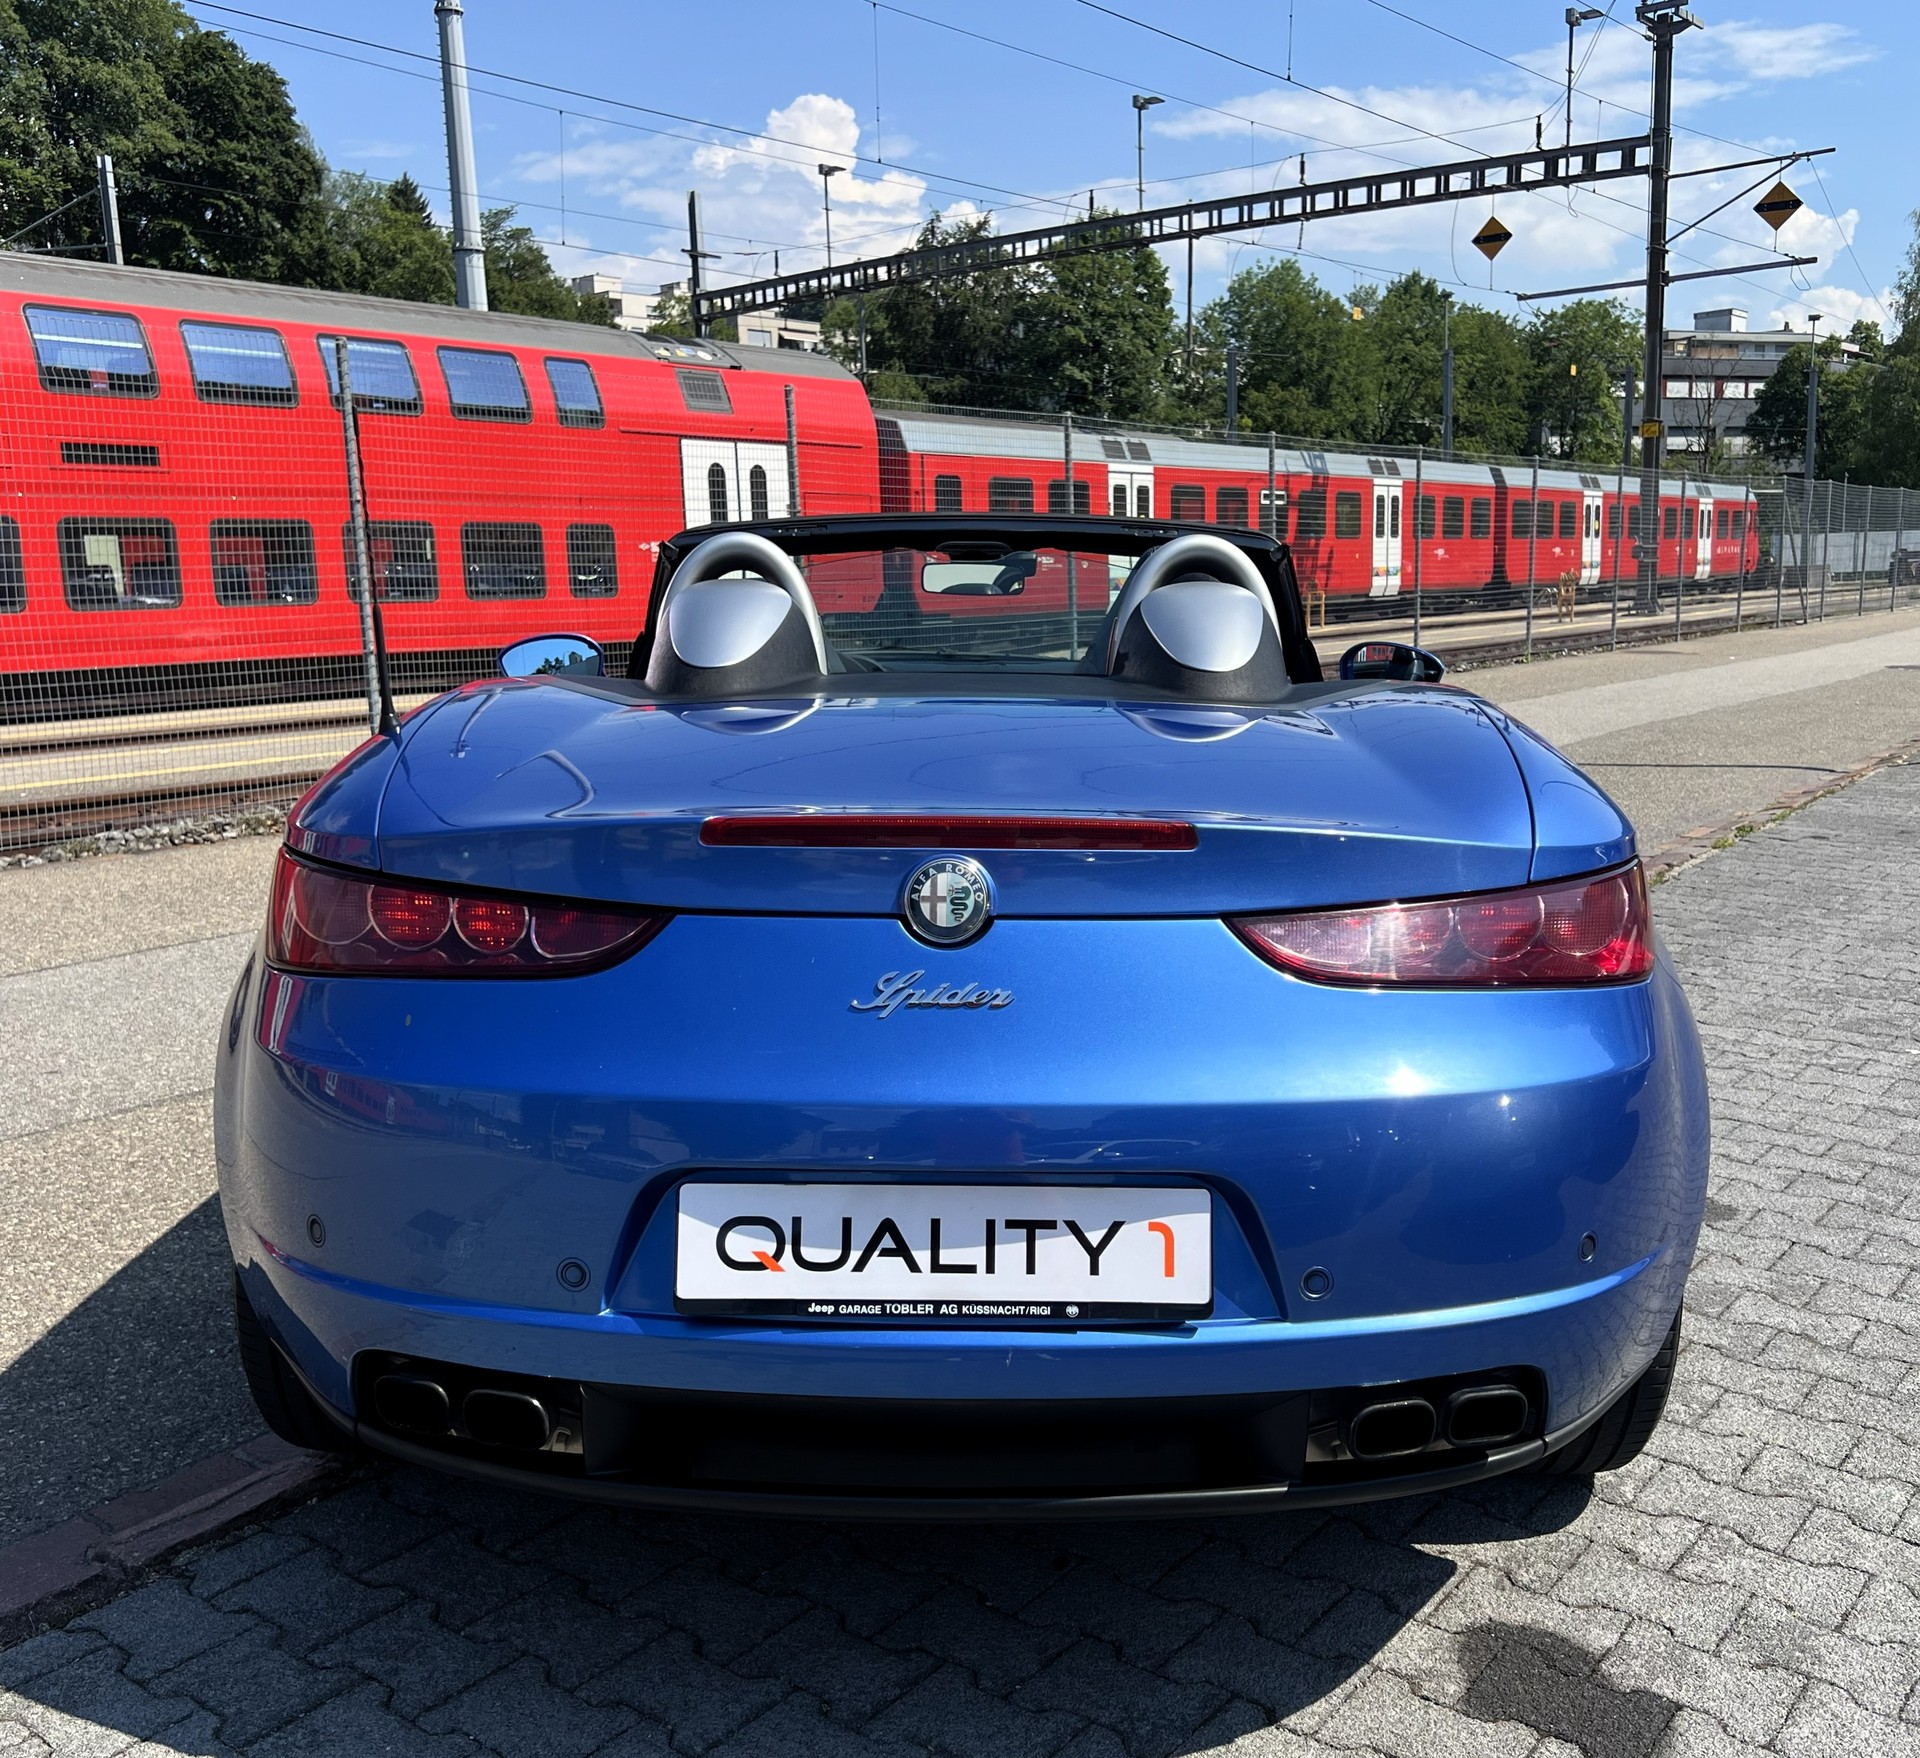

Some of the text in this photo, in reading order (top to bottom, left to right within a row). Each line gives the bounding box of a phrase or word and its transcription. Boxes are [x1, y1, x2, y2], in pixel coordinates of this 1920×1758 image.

[911, 863, 984, 902] ALFA ROMEO
[850, 969, 1015, 1019] Spider
[715, 1216, 1176, 1278] QUALITY 1
[808, 1302, 1051, 1316] Jeep GARAGE TOBLER AG KÜSSNACHT/RIGI
